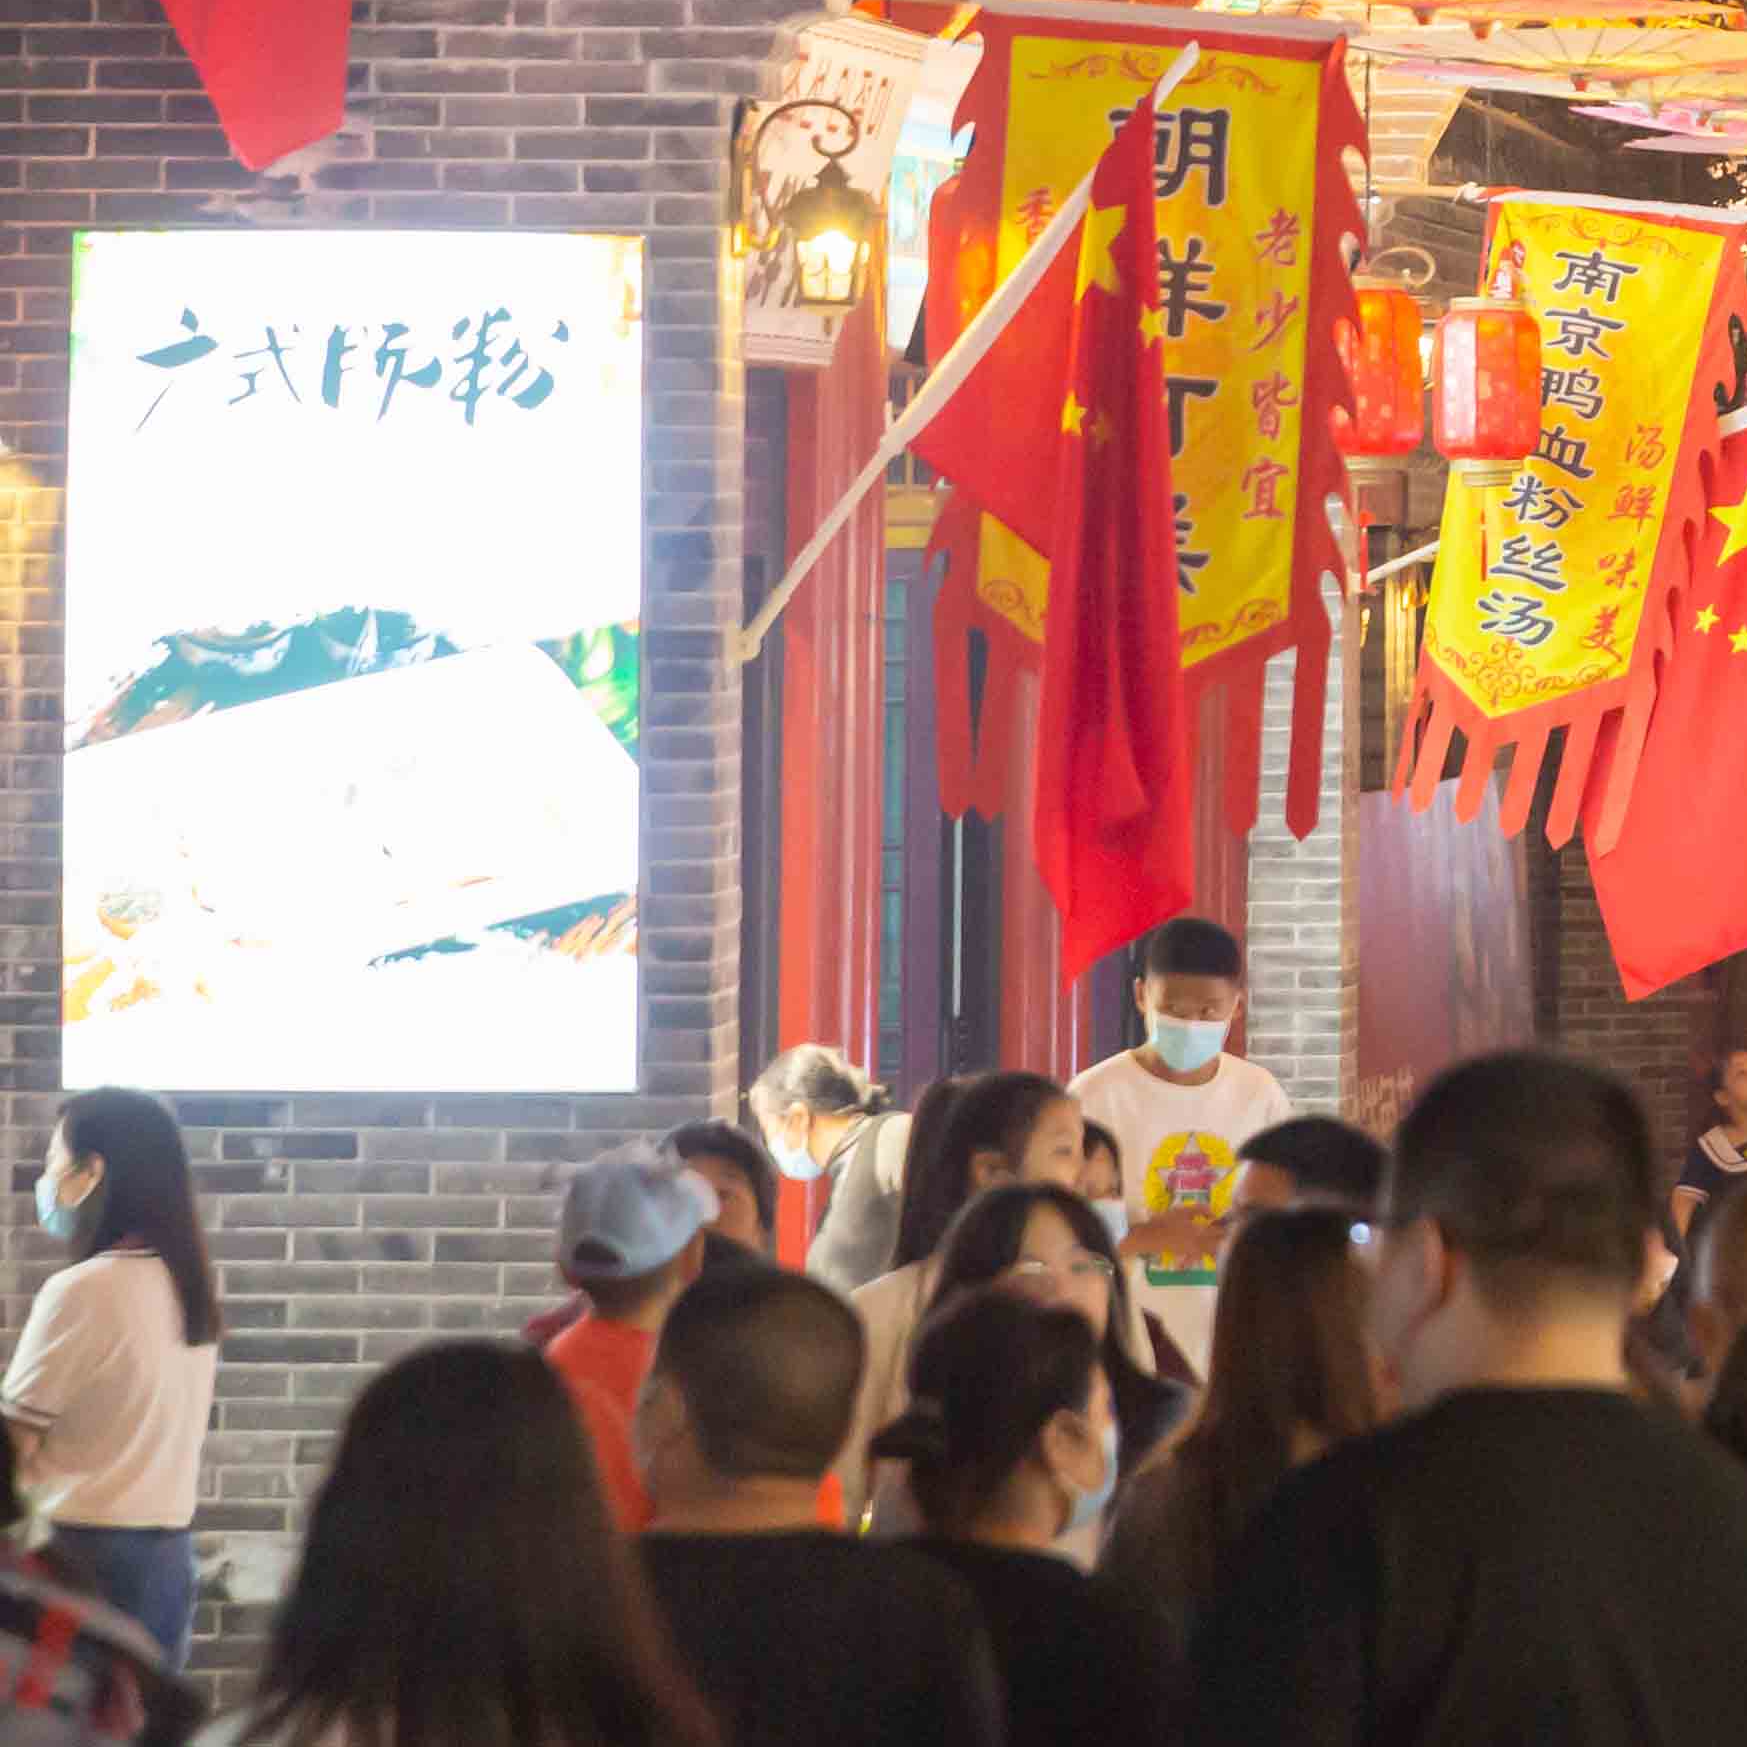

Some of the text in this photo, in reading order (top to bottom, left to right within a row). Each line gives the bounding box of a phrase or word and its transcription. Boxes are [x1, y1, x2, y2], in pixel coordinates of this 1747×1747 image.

[1238, 206, 1302, 522] 老少皆宜
[1476, 250, 1639, 646] 南京鸭血粉丝汤
[1578, 422, 1669, 662] 汤鲜味美
